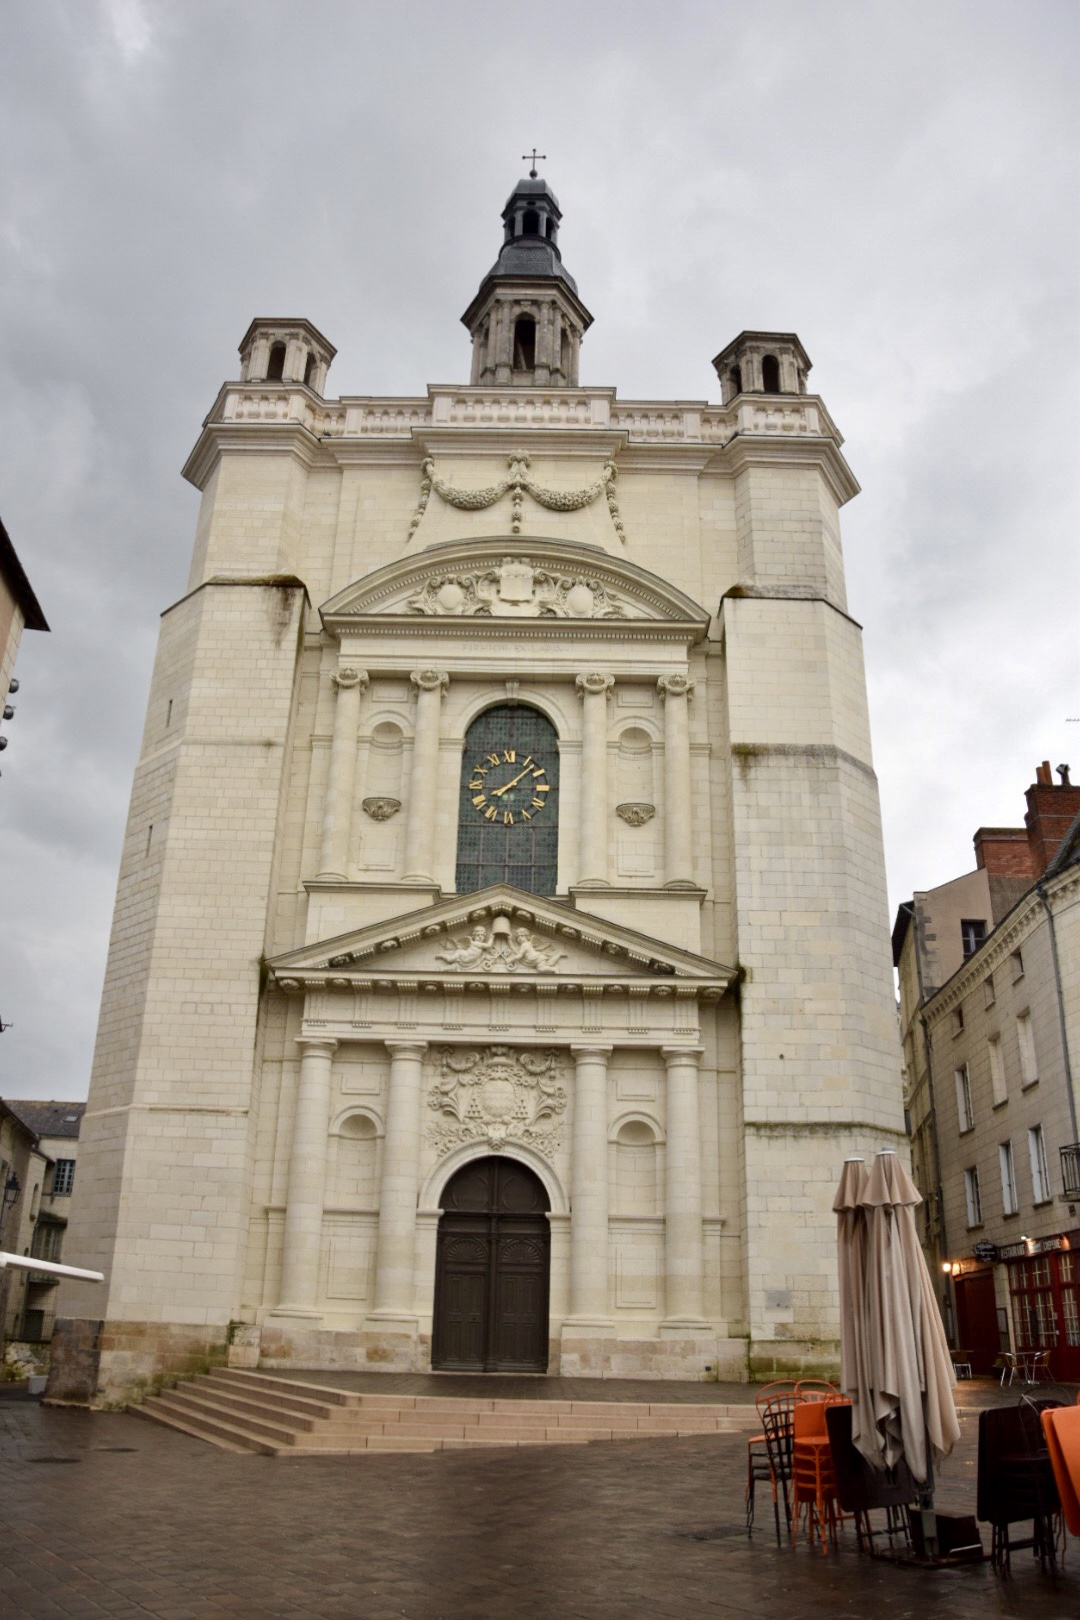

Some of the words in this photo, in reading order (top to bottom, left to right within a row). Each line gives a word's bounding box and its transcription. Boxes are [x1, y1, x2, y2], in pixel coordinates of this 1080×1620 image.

[487, 753, 500, 767] XI
[503, 750, 516, 763] XII
[523, 756, 532, 766] I
[473, 765, 488, 777] X
[469, 780, 483, 789] IX
[504, 811, 513, 824] VI
[521, 809, 531, 821] V
